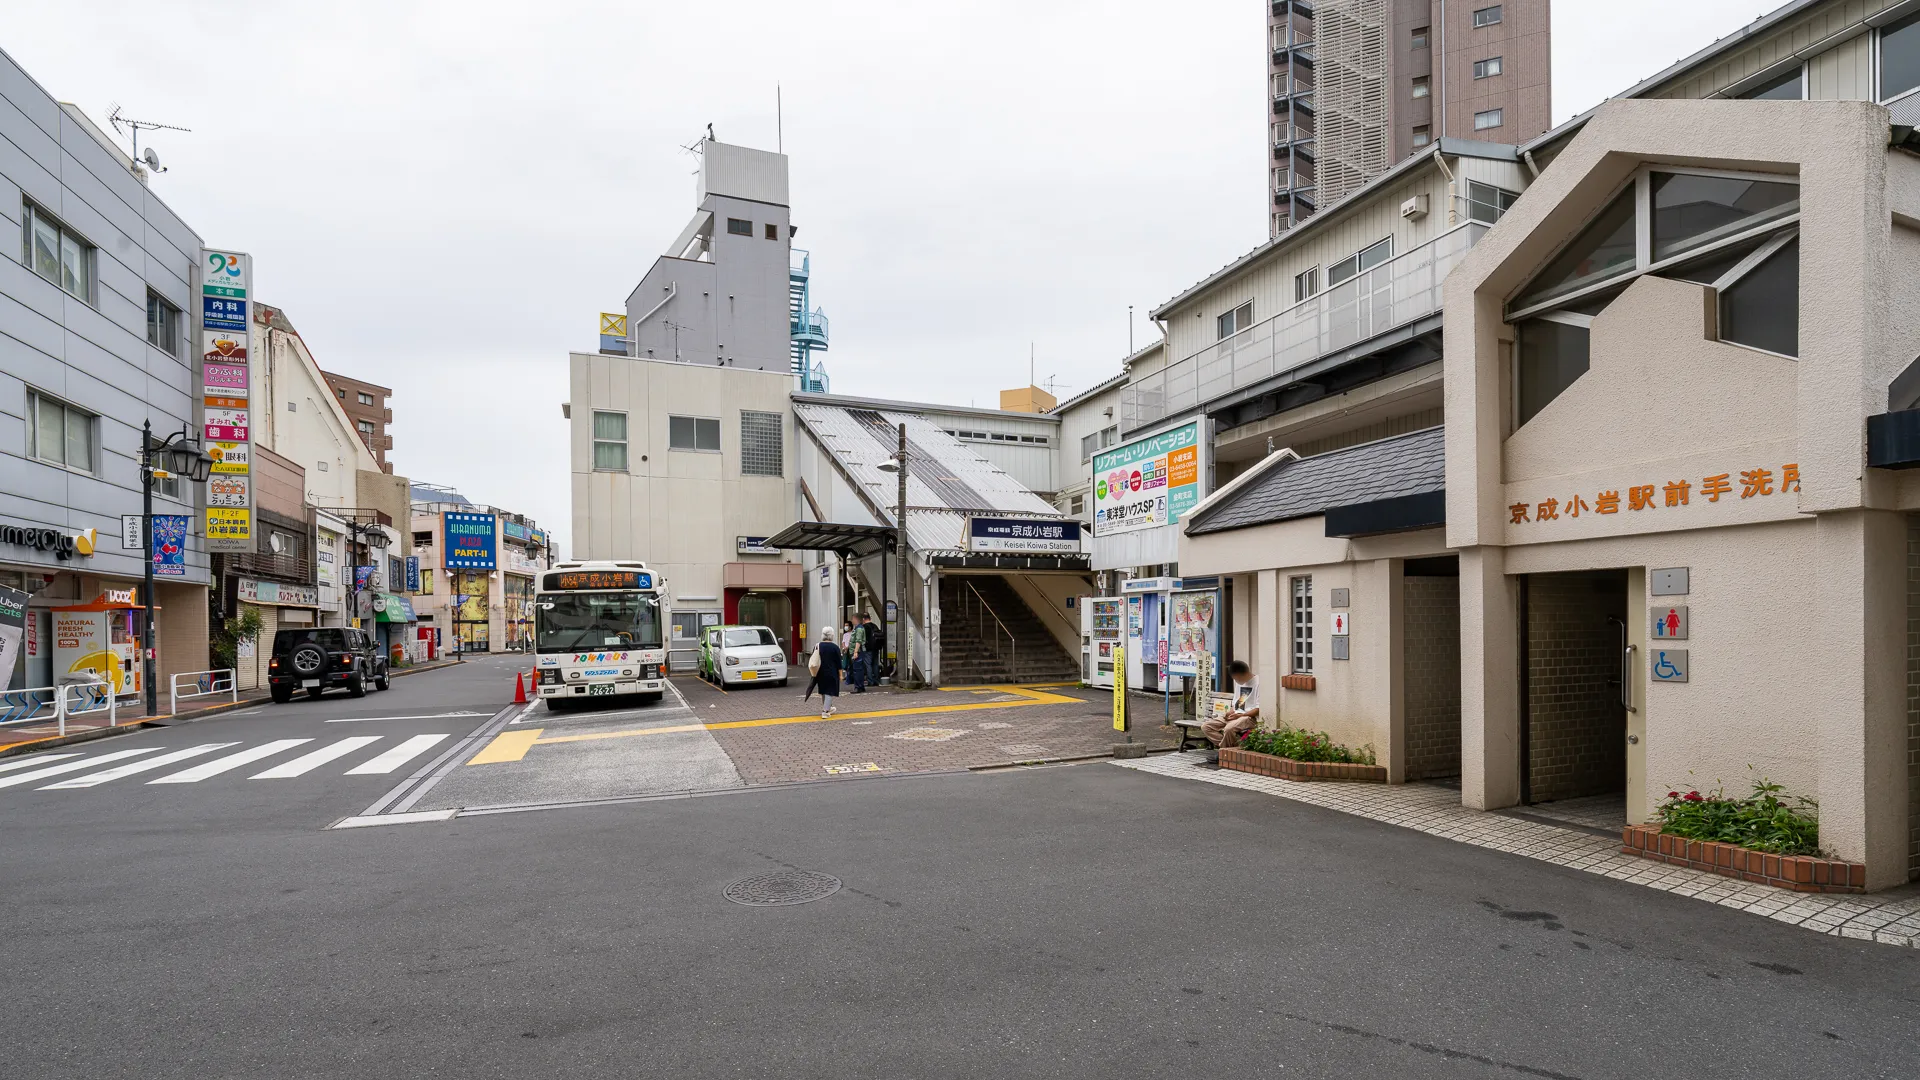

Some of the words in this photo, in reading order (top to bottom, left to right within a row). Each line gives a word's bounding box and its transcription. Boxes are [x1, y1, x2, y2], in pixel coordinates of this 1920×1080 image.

[216, 288, 234, 296] 本館
[212, 301, 237, 312] 内科
[206, 355, 246, 364] 北小岩整形外科
[208, 367, 243, 376] ひふ科
[208, 376, 244, 384] アレルギー科
[208, 418, 232, 426] すみれ
[208, 427, 245, 438] 歯科
[1096, 428, 1196, 470] リフォーム・リノベーション
[226, 452, 246, 462] 眼科
[1106, 499, 1154, 522] 東洋堂ハウスSP
[208, 526, 248, 535] 小岩薬局
[450, 524, 492, 536] HIRANUMA
[1012, 525, 1063, 538] 京成小岩駅
[460, 536, 482, 546] PLAZA
[1004, 541, 1026, 549] Keisei
[1050, 542, 1072, 550] Station
[454, 549, 488, 558] PART-II
[578, 573, 634, 582] 京成小岩駅
[0, 596, 24, 610] Uber
[0, 606, 22, 618] Eats
[594, 687, 614, 695] 26-22
